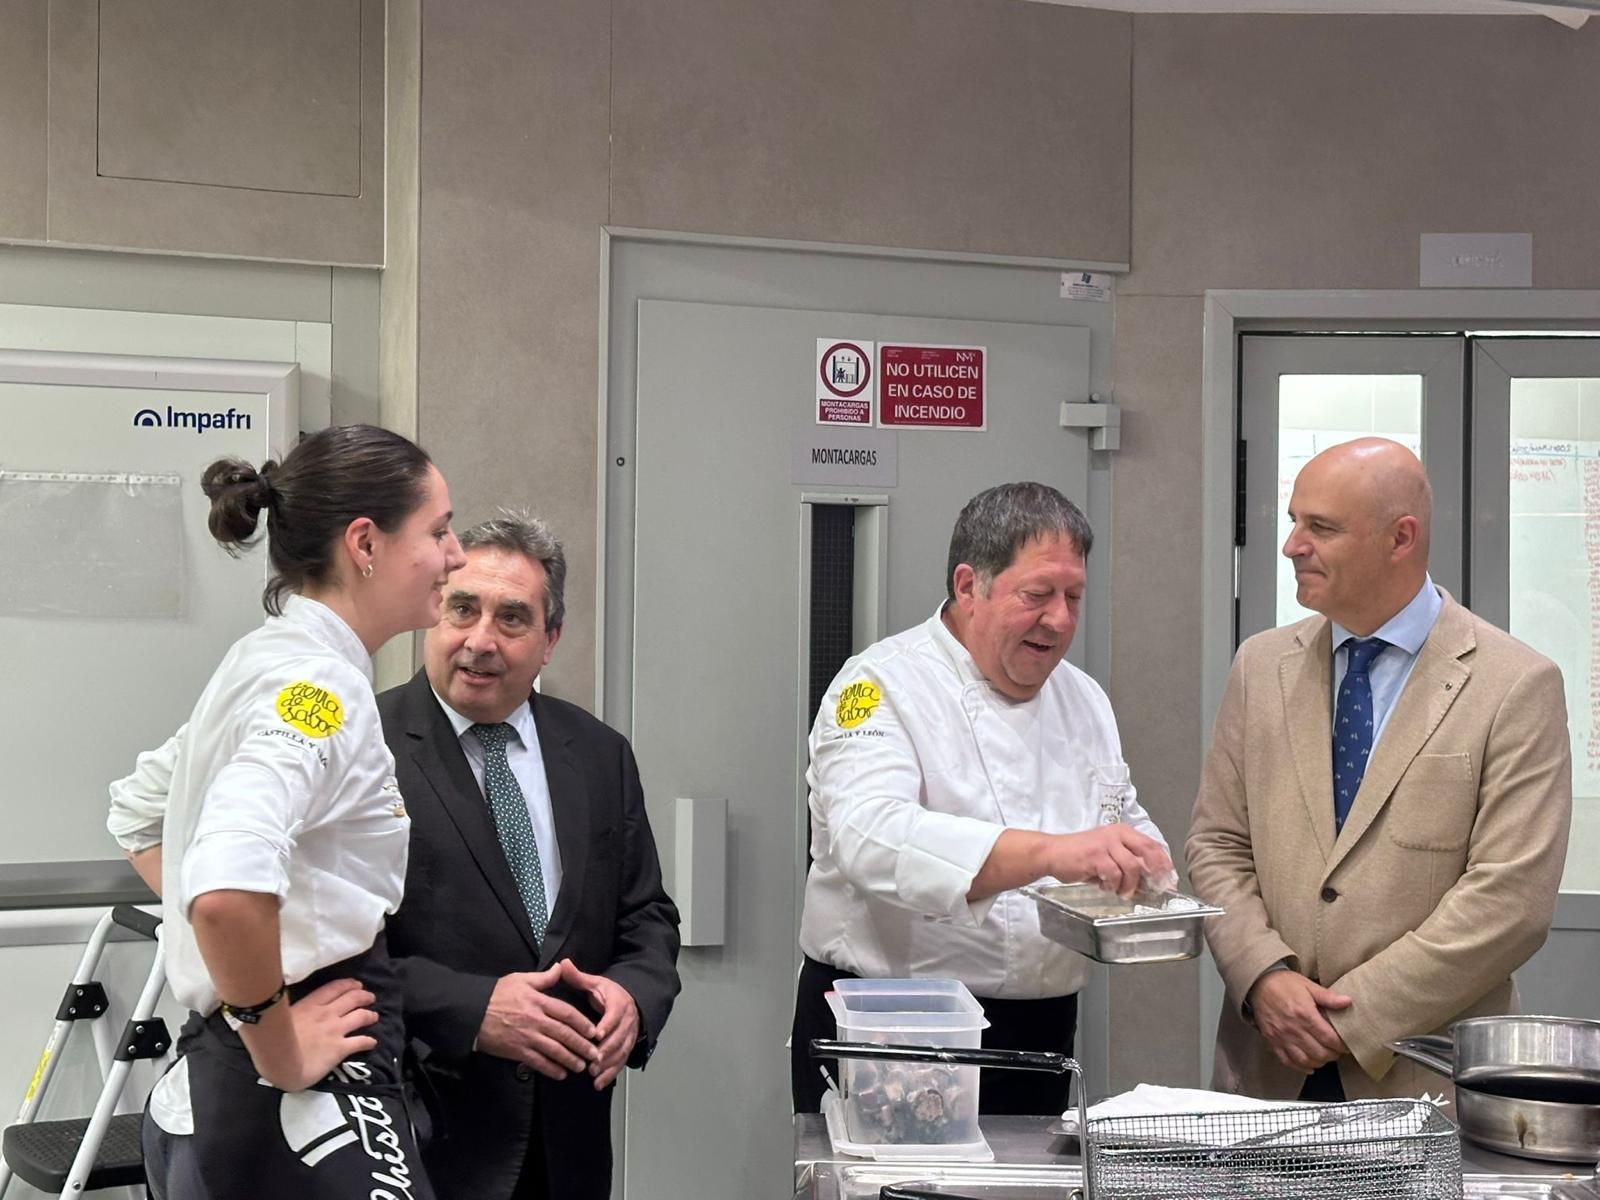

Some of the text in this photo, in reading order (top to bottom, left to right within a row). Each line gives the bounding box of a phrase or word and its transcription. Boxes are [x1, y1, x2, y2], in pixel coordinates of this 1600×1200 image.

[886, 363, 979, 379] NO UTILICEN
[888, 384, 977, 400] EN CASO DE
[821, 401, 868, 409] MONTACARGAS
[825, 407, 859, 415] PROHIBIDO
[894, 405, 966, 420] INCENDIO
[167, 405, 251, 434] Impafri
[812, 448, 877, 466] MONTACARGAS
